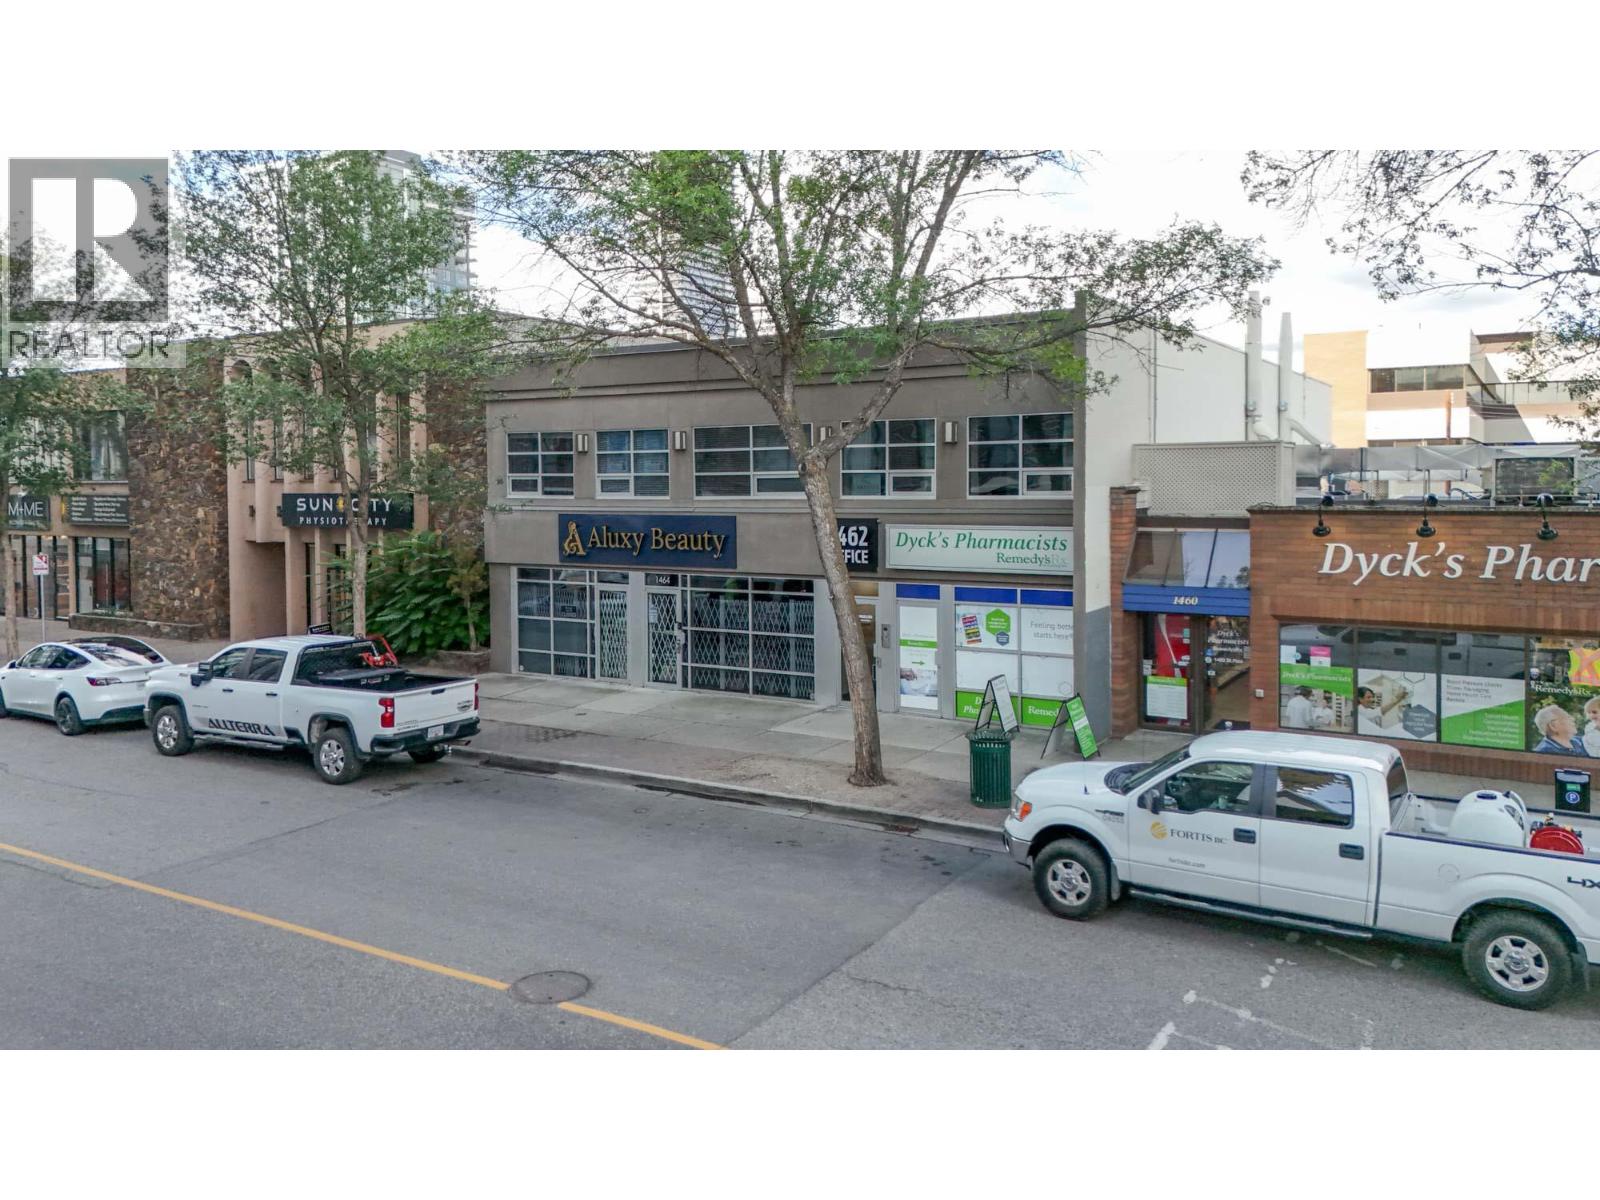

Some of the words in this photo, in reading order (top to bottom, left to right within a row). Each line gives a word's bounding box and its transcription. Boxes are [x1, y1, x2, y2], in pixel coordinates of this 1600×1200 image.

[296, 498, 333, 512] SUN
[351, 498, 393, 512] CTY
[299, 517, 387, 525] PHYSIOTEAPY
[588, 526, 645, 556] Aluxy
[651, 528, 725, 558] Beauty
[838, 525, 869, 546] 462
[896, 531, 949, 553] Dyck's
[954, 532, 1068, 552] Pharmacists
[842, 550, 869, 564] FICE
[1317, 541, 1465, 586] Dyck's
[656, 576, 670, 584] 1464
[1173, 596, 1198, 605] 1460
[208, 718, 276, 736] ALLTERRA
[1170, 828, 1213, 843] FORTIS
